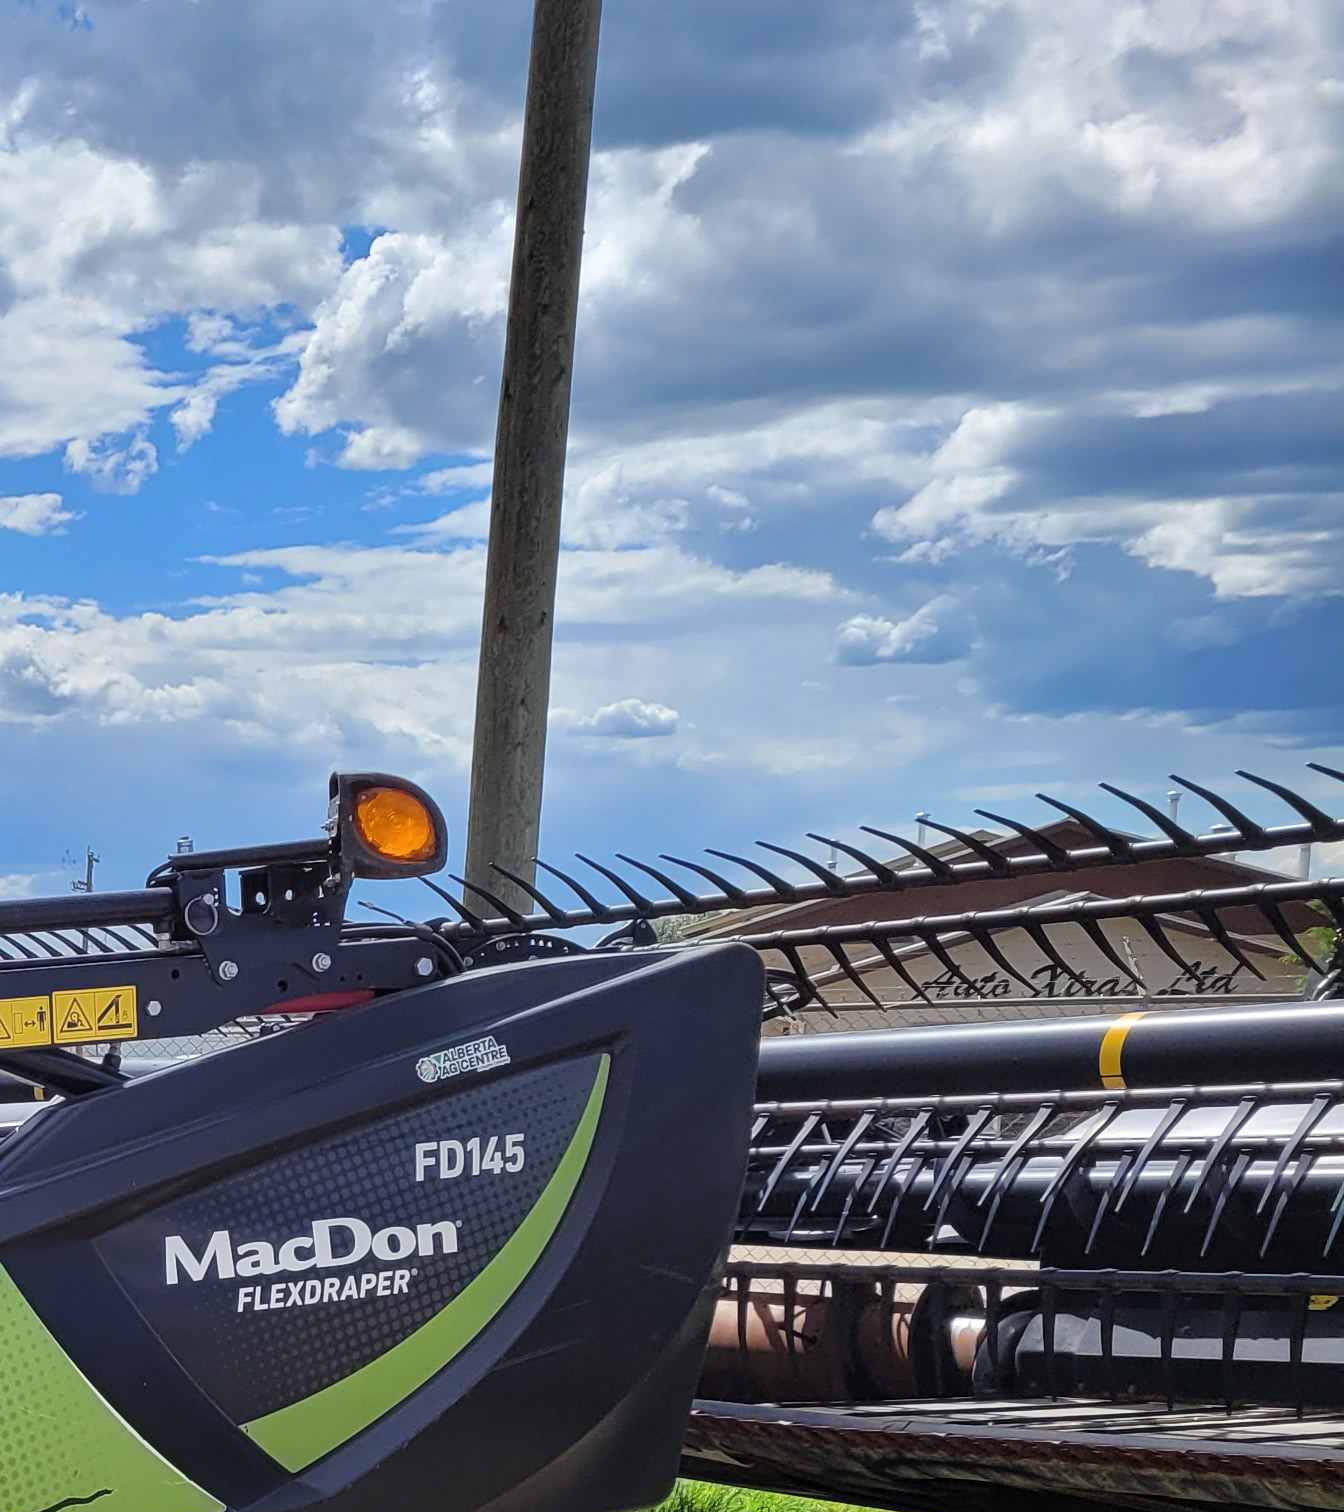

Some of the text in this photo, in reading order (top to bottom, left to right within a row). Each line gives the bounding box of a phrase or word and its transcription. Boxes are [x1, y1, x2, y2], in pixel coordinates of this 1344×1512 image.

[911, 965, 1011, 1000] Auto
[1155, 961, 1244, 996] Ltd
[440, 1063, 459, 1077] AG
[460, 1046, 507, 1070] CENTRE
[442, 1038, 496, 1064] ALBERTA
[415, 1133, 525, 1182] FD145
[165, 1217, 459, 1285] MacDon
[237, 1269, 410, 1313] FLEXDRAPER
